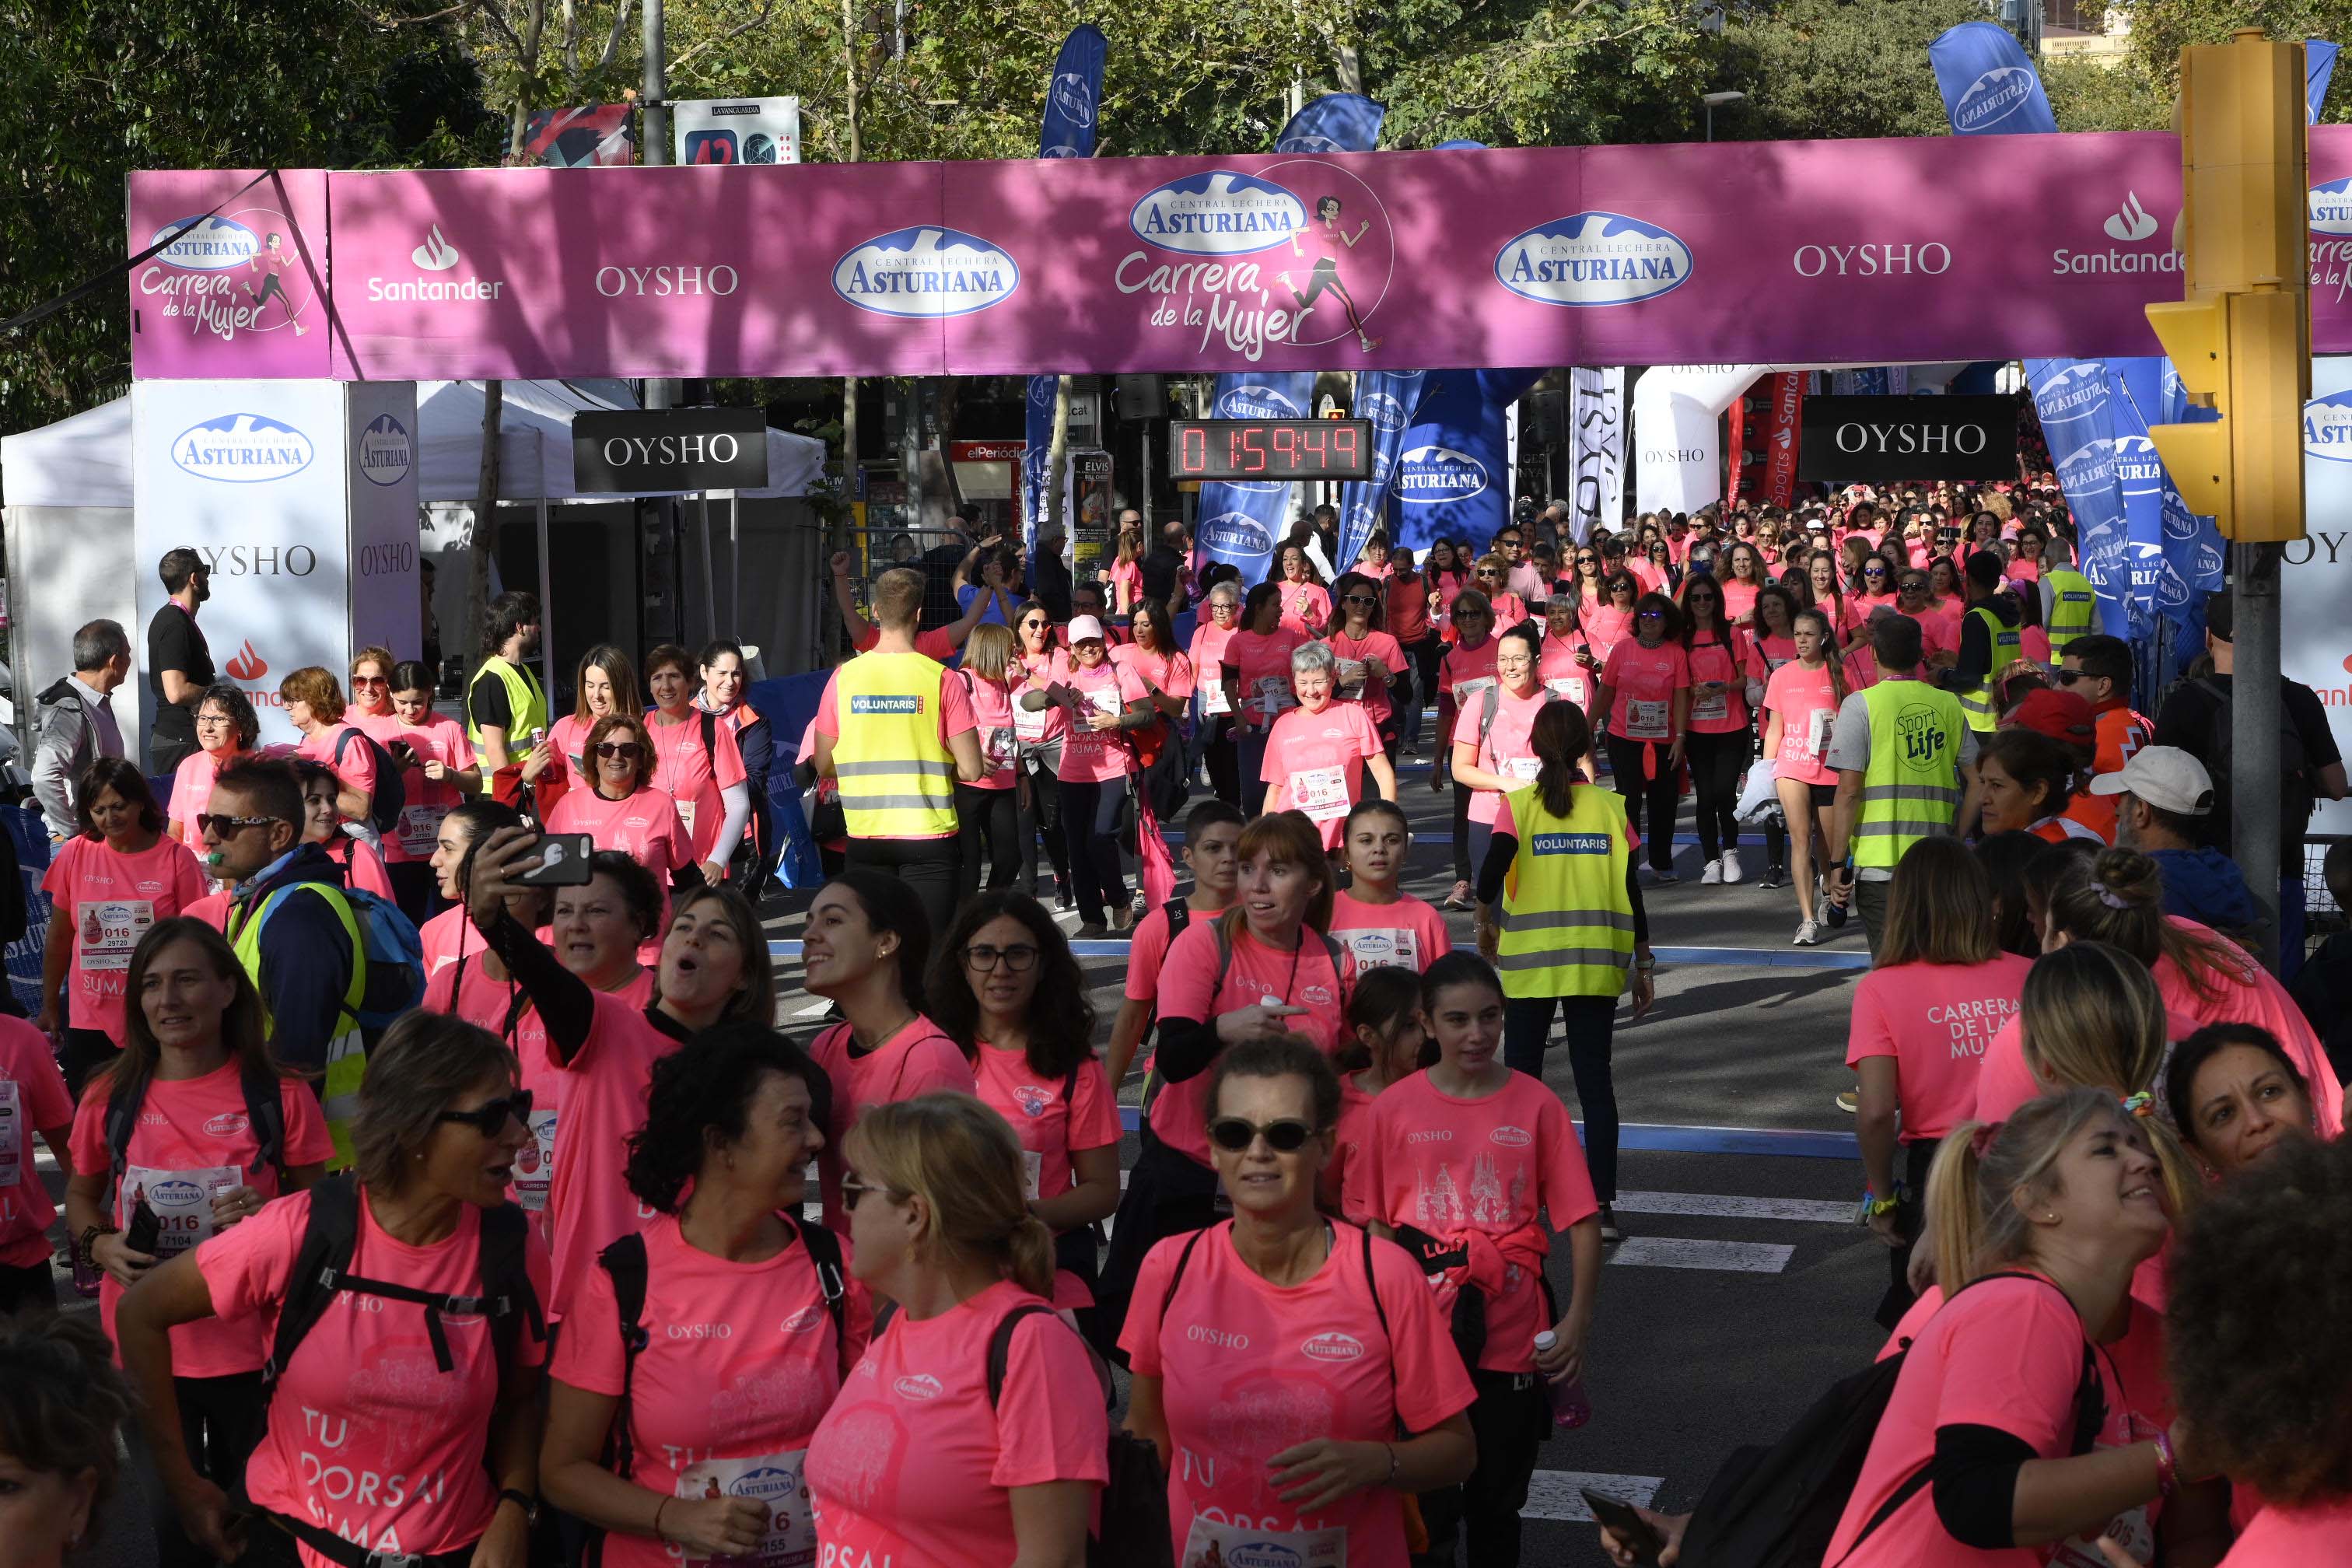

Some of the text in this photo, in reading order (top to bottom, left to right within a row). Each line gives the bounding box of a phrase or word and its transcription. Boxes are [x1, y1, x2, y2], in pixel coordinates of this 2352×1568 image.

[1171, 198, 1288, 209] CENTRAL LECHERA
[1143, 203, 1293, 234] ASTURIANA
[159, 235, 251, 256] ASTURIANA
[1540, 243, 1671, 255] CENTRAL LECHERA
[1510, 249, 1678, 282] ASTURIANA
[1794, 242, 1951, 277] OYSHO
[2053, 249, 2186, 275] Santand
[141, 266, 230, 295] Carrera
[596, 264, 738, 296] OYSHO
[847, 261, 1004, 293] ASTURIANA
[1115, 251, 1262, 294] Carrera
[2326, 263, 2339, 285] la
[368, 276, 502, 302] Santander
[163, 292, 266, 340] de la Mujer
[1151, 288, 1315, 362] de la Mujer
[1836, 422, 1986, 453] OYSHO
[183, 439, 304, 465] ASTURIANA
[362, 440, 408, 468] ASTURIANA
[604, 433, 739, 467] OYSHO
[967, 446, 1026, 459] elPeriódi
[1645, 448, 1704, 464] OYSHO
[1085, 462, 1108, 471] ELVIS
[1392, 474, 1481, 491] ASTURIANA
[1205, 524, 1267, 551] ASTURIANA
[173, 545, 317, 576] YSHO
[361, 542, 411, 576] OYSHO
[852, 698, 916, 712] VOLUNTARIS
[1787, 723, 1801, 733] TU
[1898, 709, 1937, 737] Sport
[1072, 743, 1103, 754] SUMA
[1906, 727, 1945, 760] Life
[1310, 789, 1328, 798] 016
[1534, 838, 1608, 851] VOLUNTARIS
[84, 874, 114, 885] OYSHO
[103, 910, 131, 919] ASTURIANA
[104, 927, 130, 938] 016
[1927, 998, 2021, 1023] CARRERA
[1950, 1015, 2007, 1039] DE LA
[208, 1121, 246, 1132] ASTURIANA
[1408, 1130, 1453, 1144] OYSHO
[1493, 1132, 1529, 1143] ASTURIANA
[153, 1188, 200, 1200] ASTURIANA
[159, 1215, 200, 1231] 016
[667, 1324, 732, 1339] OYSHO
[1188, 1325, 1249, 1349] OYSHO
[1304, 1341, 1360, 1357] ASTURIANA
[301, 1405, 347, 1447] TU
[1181, 1446, 1215, 1487] TU
[736, 1480, 792, 1496] ASTURIANA
[1234, 1552, 1297, 1568] ASTURIANA
